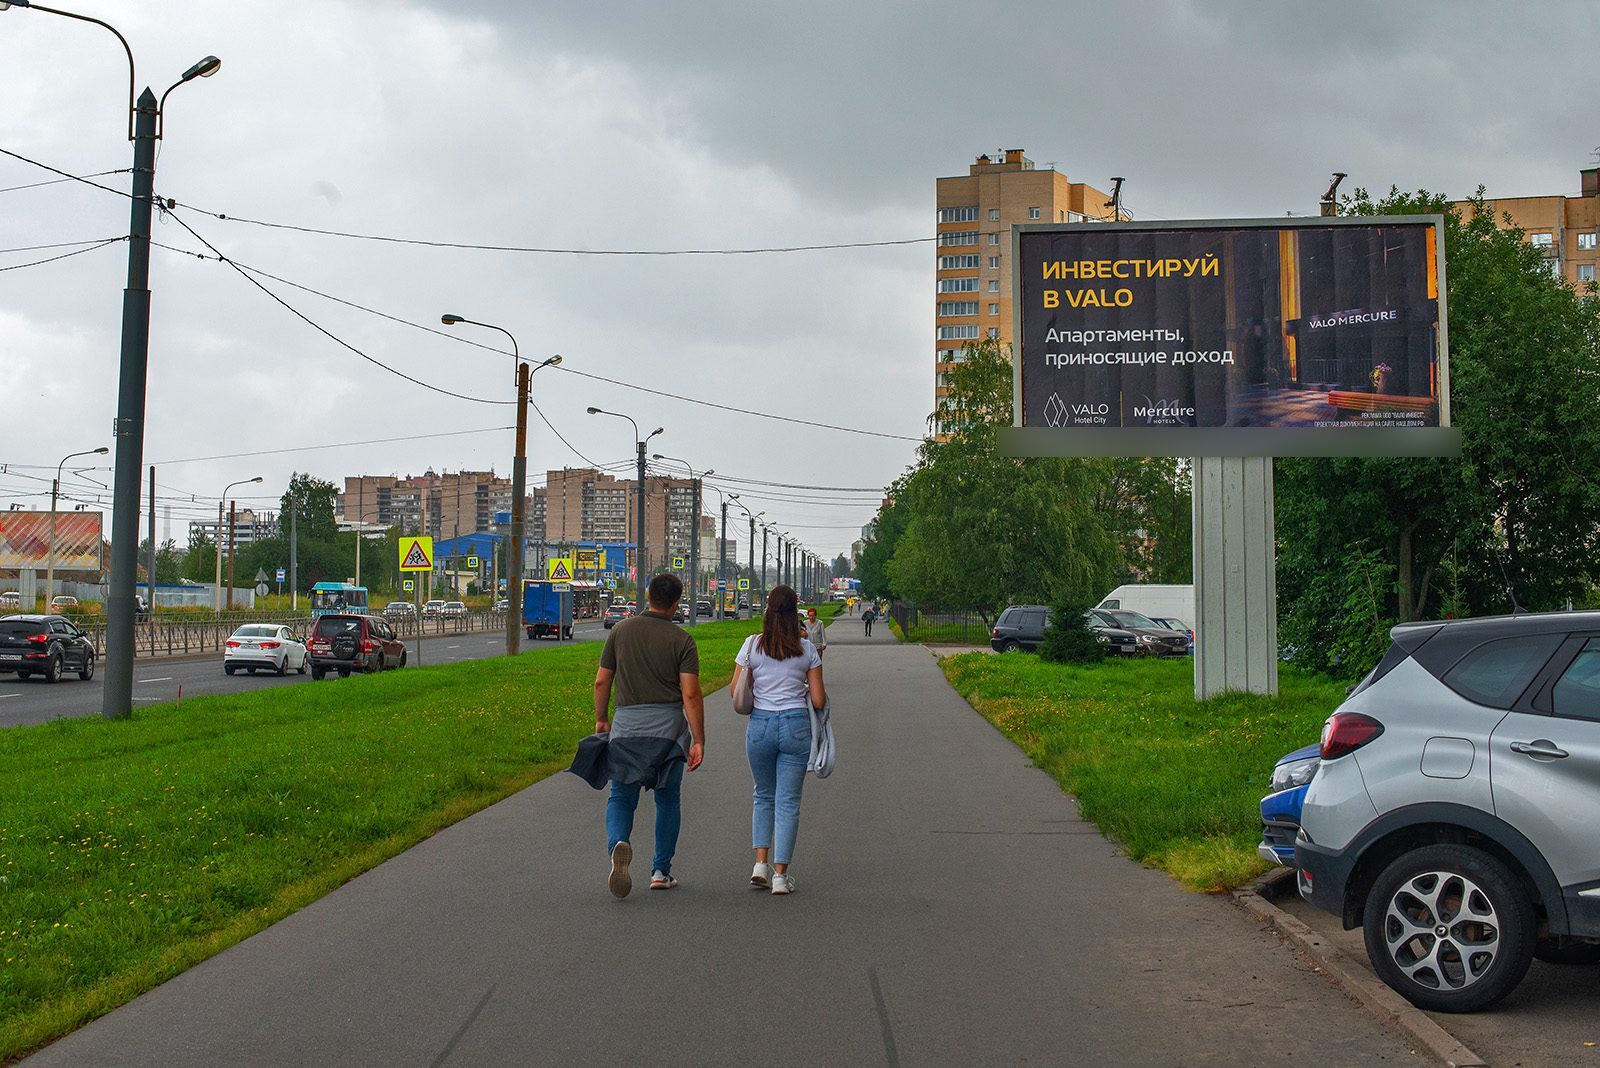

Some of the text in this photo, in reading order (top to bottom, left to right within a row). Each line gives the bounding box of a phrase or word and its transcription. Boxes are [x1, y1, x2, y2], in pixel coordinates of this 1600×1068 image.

[1042, 253, 1220, 280] ИНВЕСТИРУЙ
[1066, 287, 1134, 308] VALO
[1309, 310, 1397, 328] VALO MERCURE
[1045, 328, 1185, 346] Апартаменты,
[1045, 350, 1235, 369] приносящие доход
[1071, 403, 1109, 415] VALO
[1133, 406, 1195, 417] Mercure
[1093, 416, 1107, 425] City
